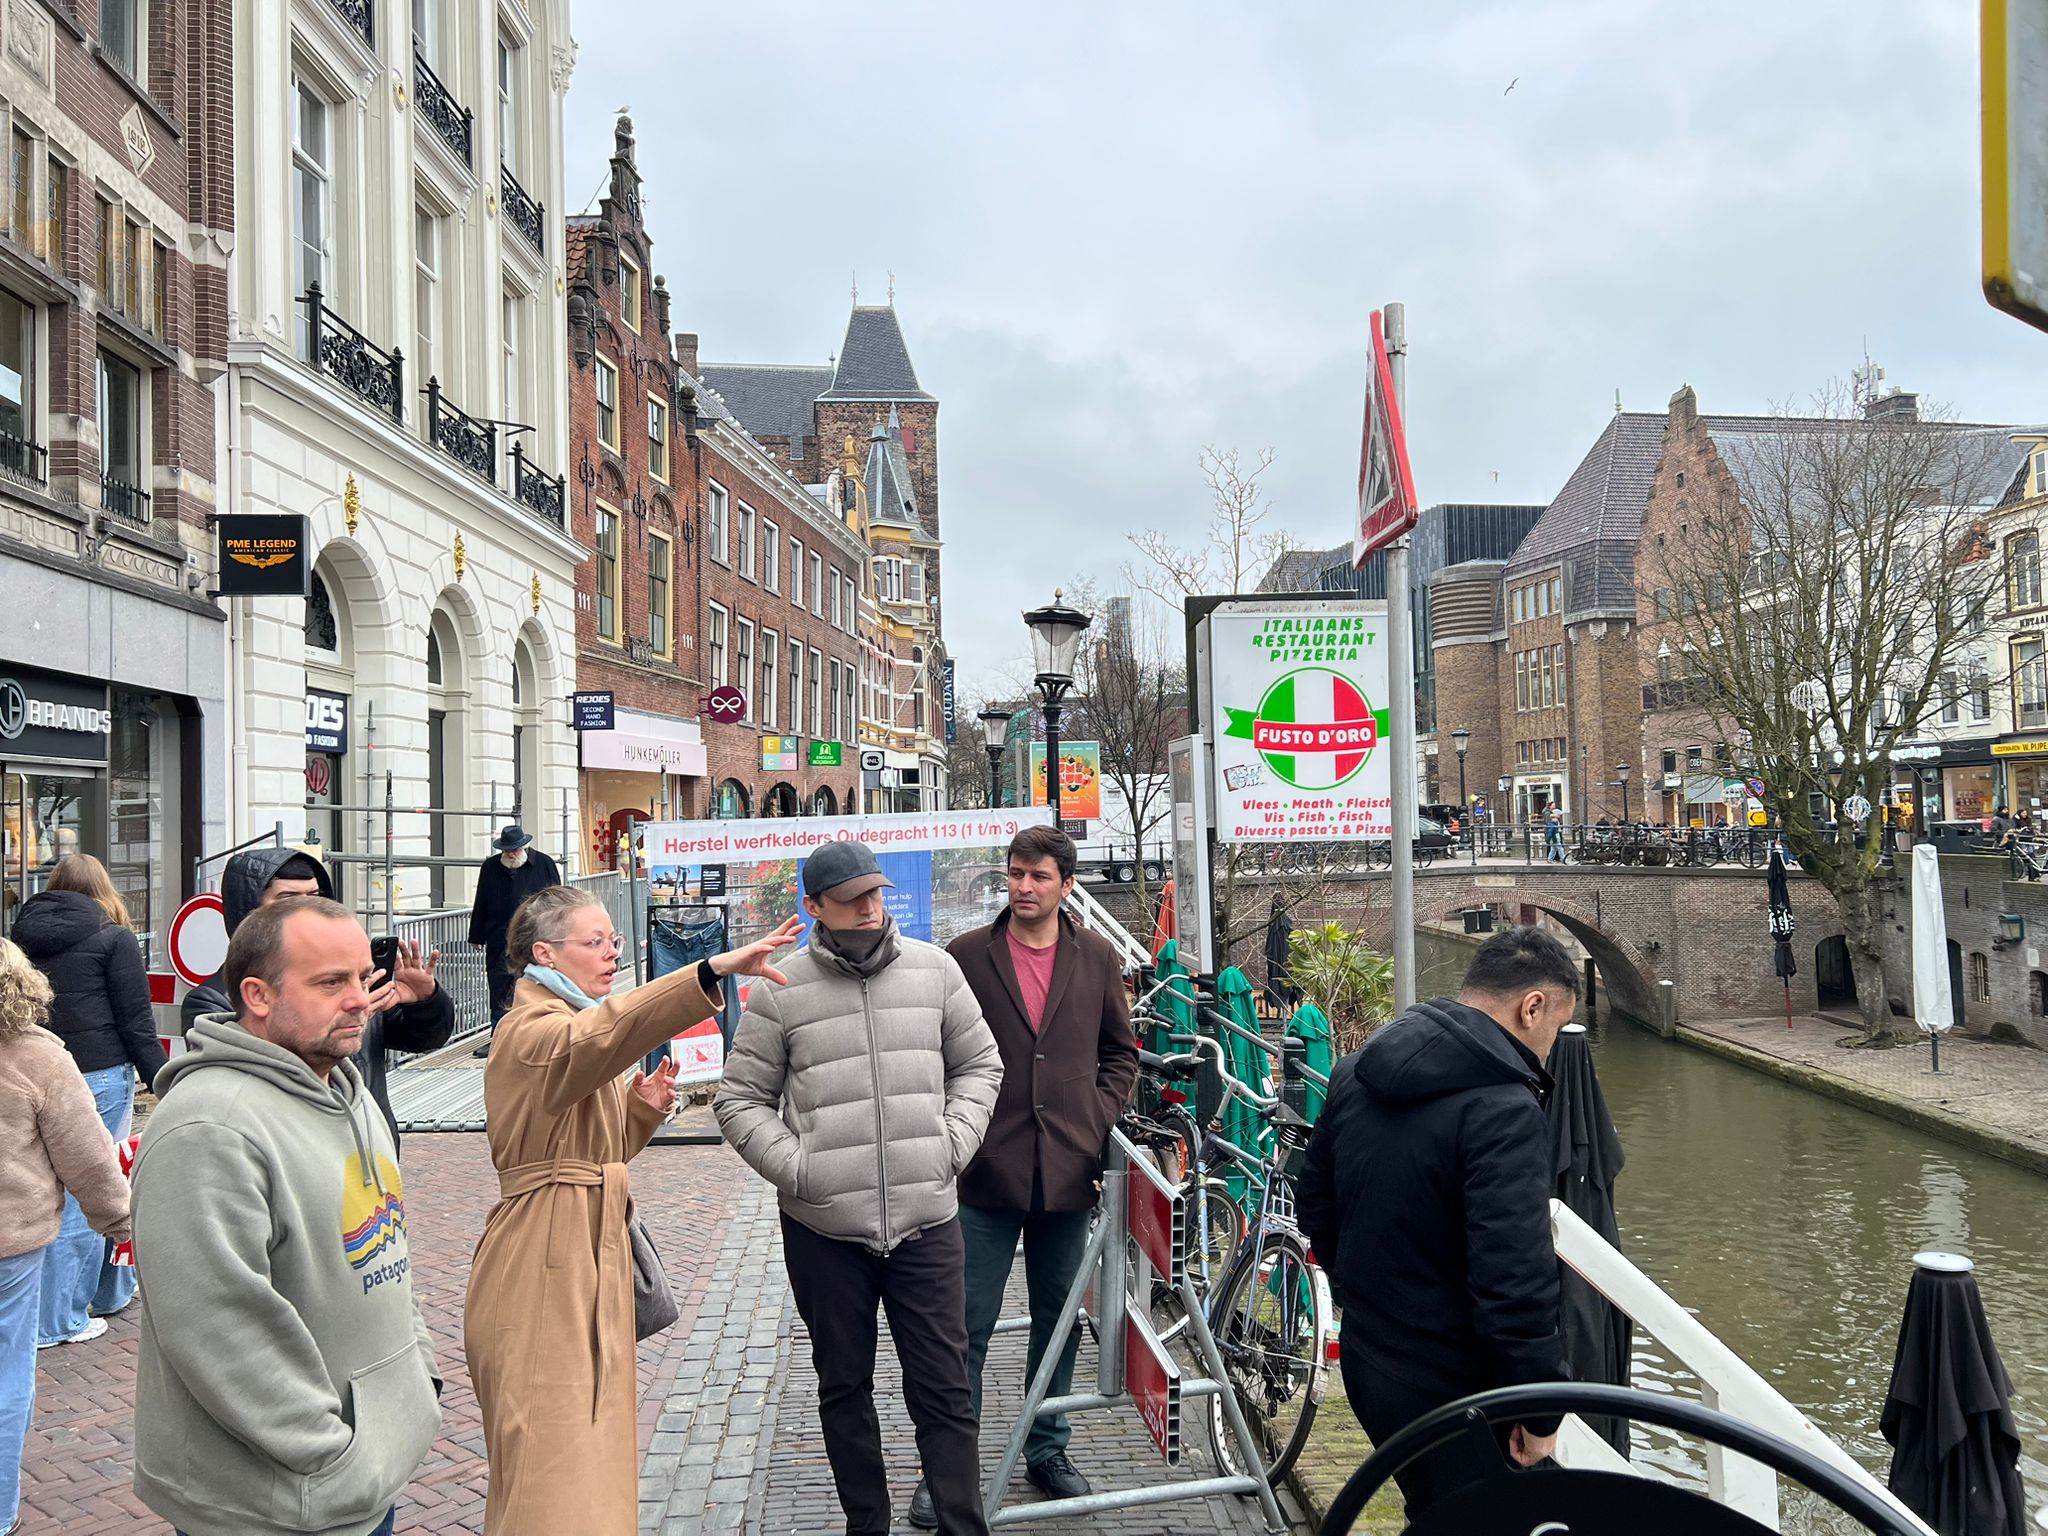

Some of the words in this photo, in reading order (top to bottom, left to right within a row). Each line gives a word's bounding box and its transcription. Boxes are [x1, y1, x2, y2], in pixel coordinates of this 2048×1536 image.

[227, 539, 251, 548] PME
[253, 539, 297, 548] LEGEND
[578, 592, 590, 611] 111
[1263, 618, 1364, 632] ITALIAANS
[682, 634, 694, 649] 111
[1252, 632, 1376, 647] RESTAURANT
[1269, 648, 1358, 662] PIZZERIA
[25, 699, 112, 734] BRANDS
[1258, 727, 1314, 744] FUSTO
[1318, 726, 1372, 743] D'ORO
[1242, 799, 1278, 810] Vlees
[1292, 798, 1333, 809] Meath
[1346, 797, 1391, 808] Fleisch
[1264, 812, 1284, 823] Vis
[1297, 811, 1325, 822] Fish
[1338, 811, 1372, 822] Fisch
[664, 835, 728, 854] Herstel
[734, 831, 833, 849] werfkelders
[837, 825, 929, 845] Oudegracht
[933, 824, 957, 838] 113
[961, 822, 972, 840] (1
[977, 821, 1002, 835] t/m
[1006, 820, 1019, 836] 3)
[1234, 825, 1286, 837] Diverse
[1289, 824, 1338, 838] pasta's
[1343, 824, 1351, 834] &
